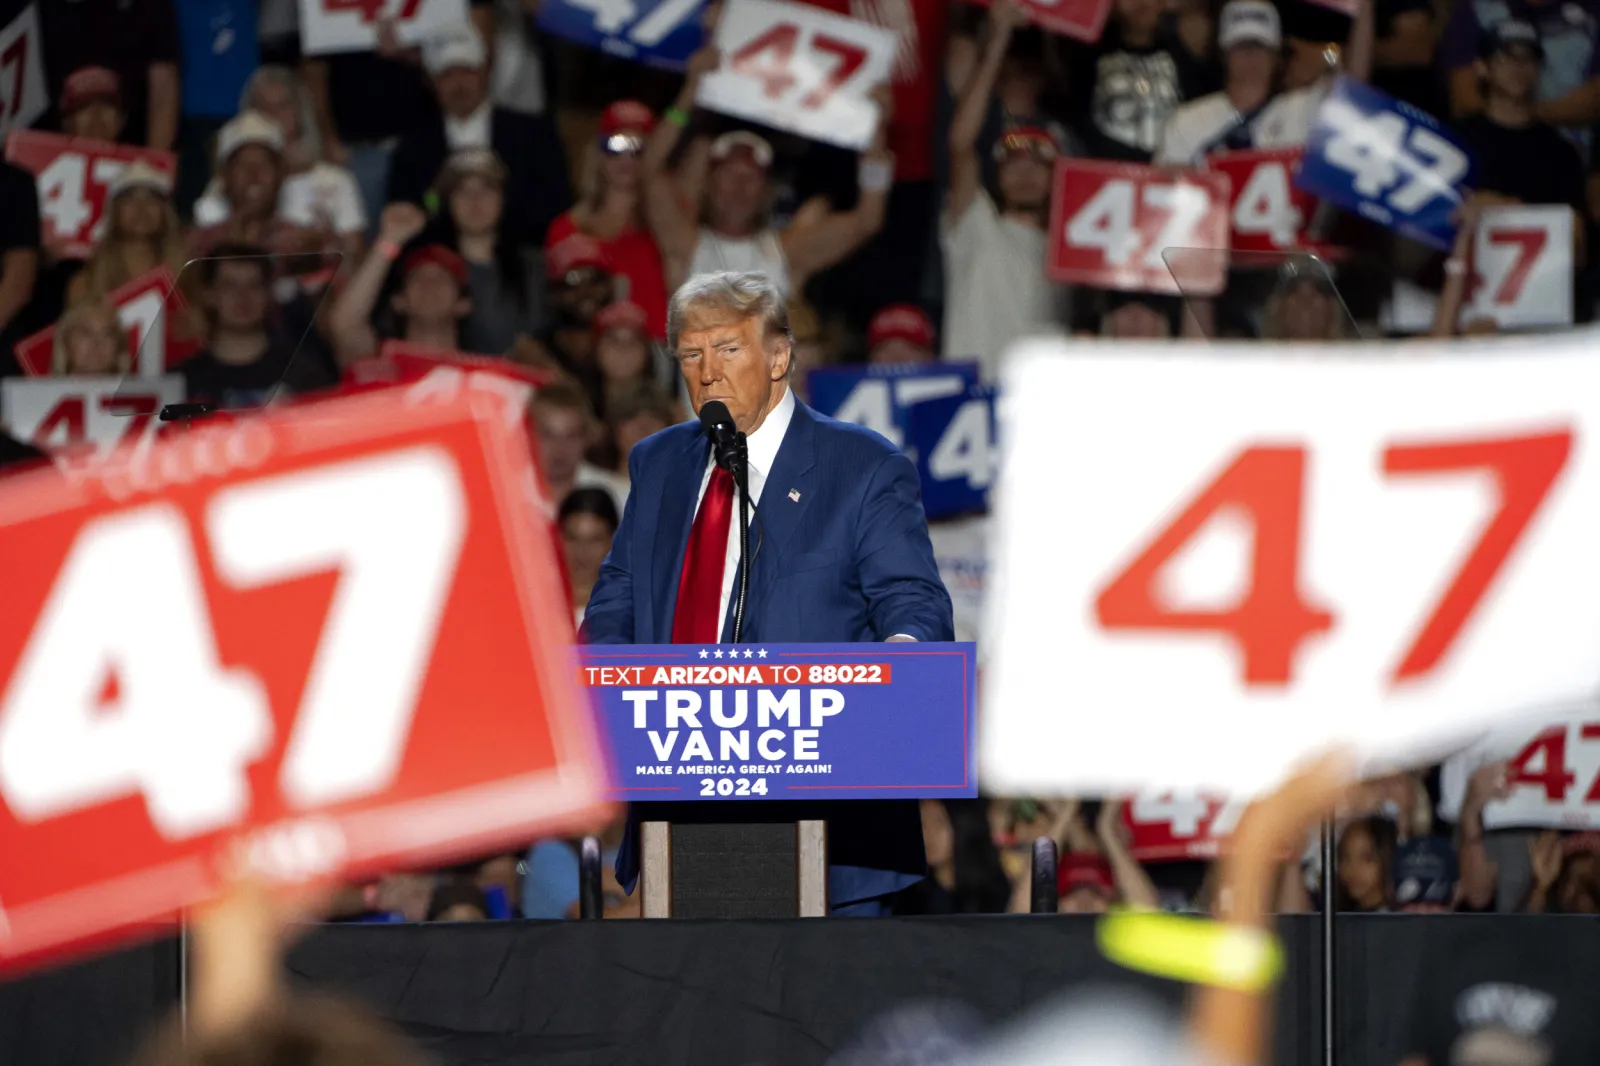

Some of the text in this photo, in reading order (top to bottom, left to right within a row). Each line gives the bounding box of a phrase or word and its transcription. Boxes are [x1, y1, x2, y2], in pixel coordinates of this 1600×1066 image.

[730, 21, 870, 110] 47
[1322, 97, 1472, 214] 47
[1065, 180, 1210, 269] 47
[30, 393, 162, 470] 47
[1090, 420, 1580, 695] 47
[0, 440, 470, 842] 47
[585, 665, 882, 685] TEXT ARIZONA TO 88022
[622, 688, 845, 729] TRUMP
[647, 729, 820, 762] VANCE
[636, 764, 832, 775] MAKE AMERICA GREAT AGAIN!
[700, 778, 768, 796] 2024
